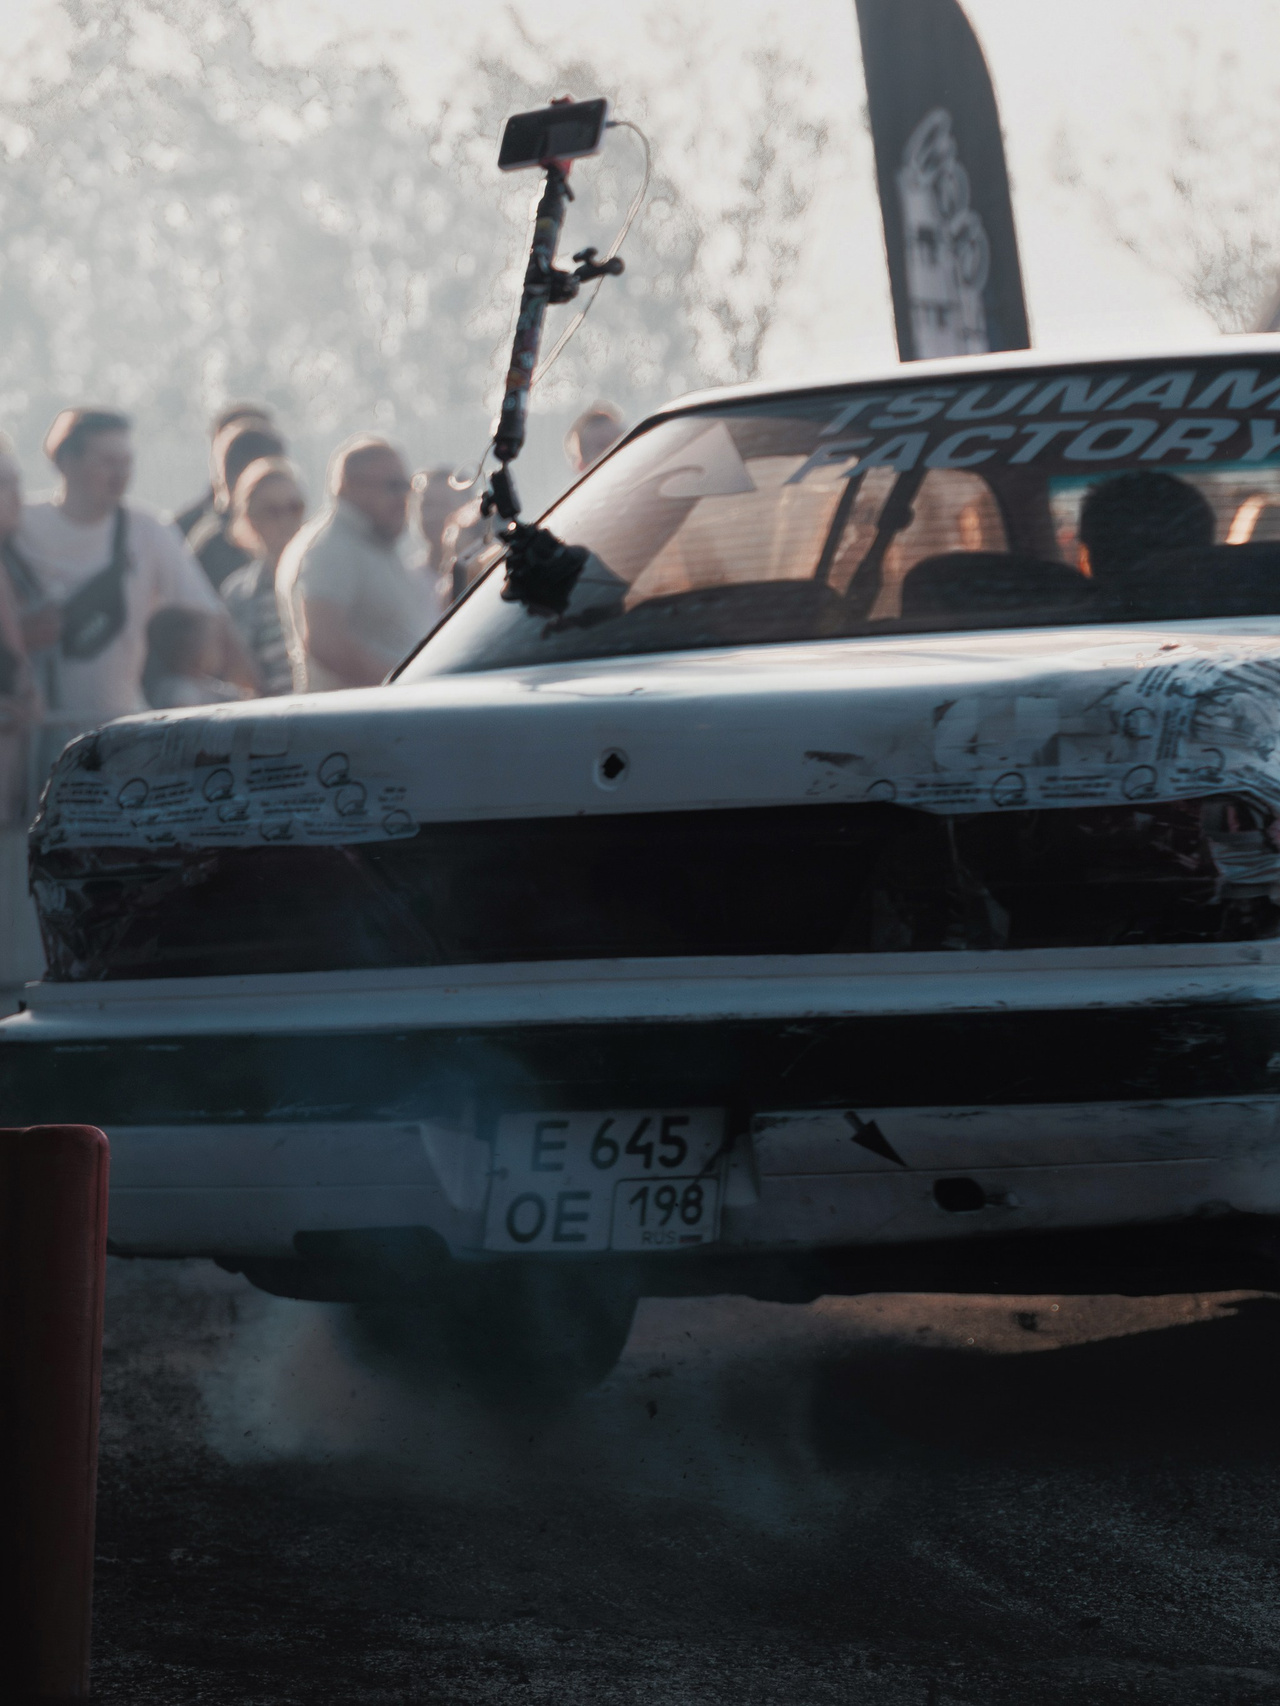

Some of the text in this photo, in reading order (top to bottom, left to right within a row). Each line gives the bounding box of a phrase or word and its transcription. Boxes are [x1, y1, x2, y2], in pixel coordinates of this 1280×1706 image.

[531, 1115, 691, 1173] E 645
[506, 1190, 592, 1245] OE
[629, 1183, 705, 1227] 198
[641, 1230, 677, 1246] RUS
